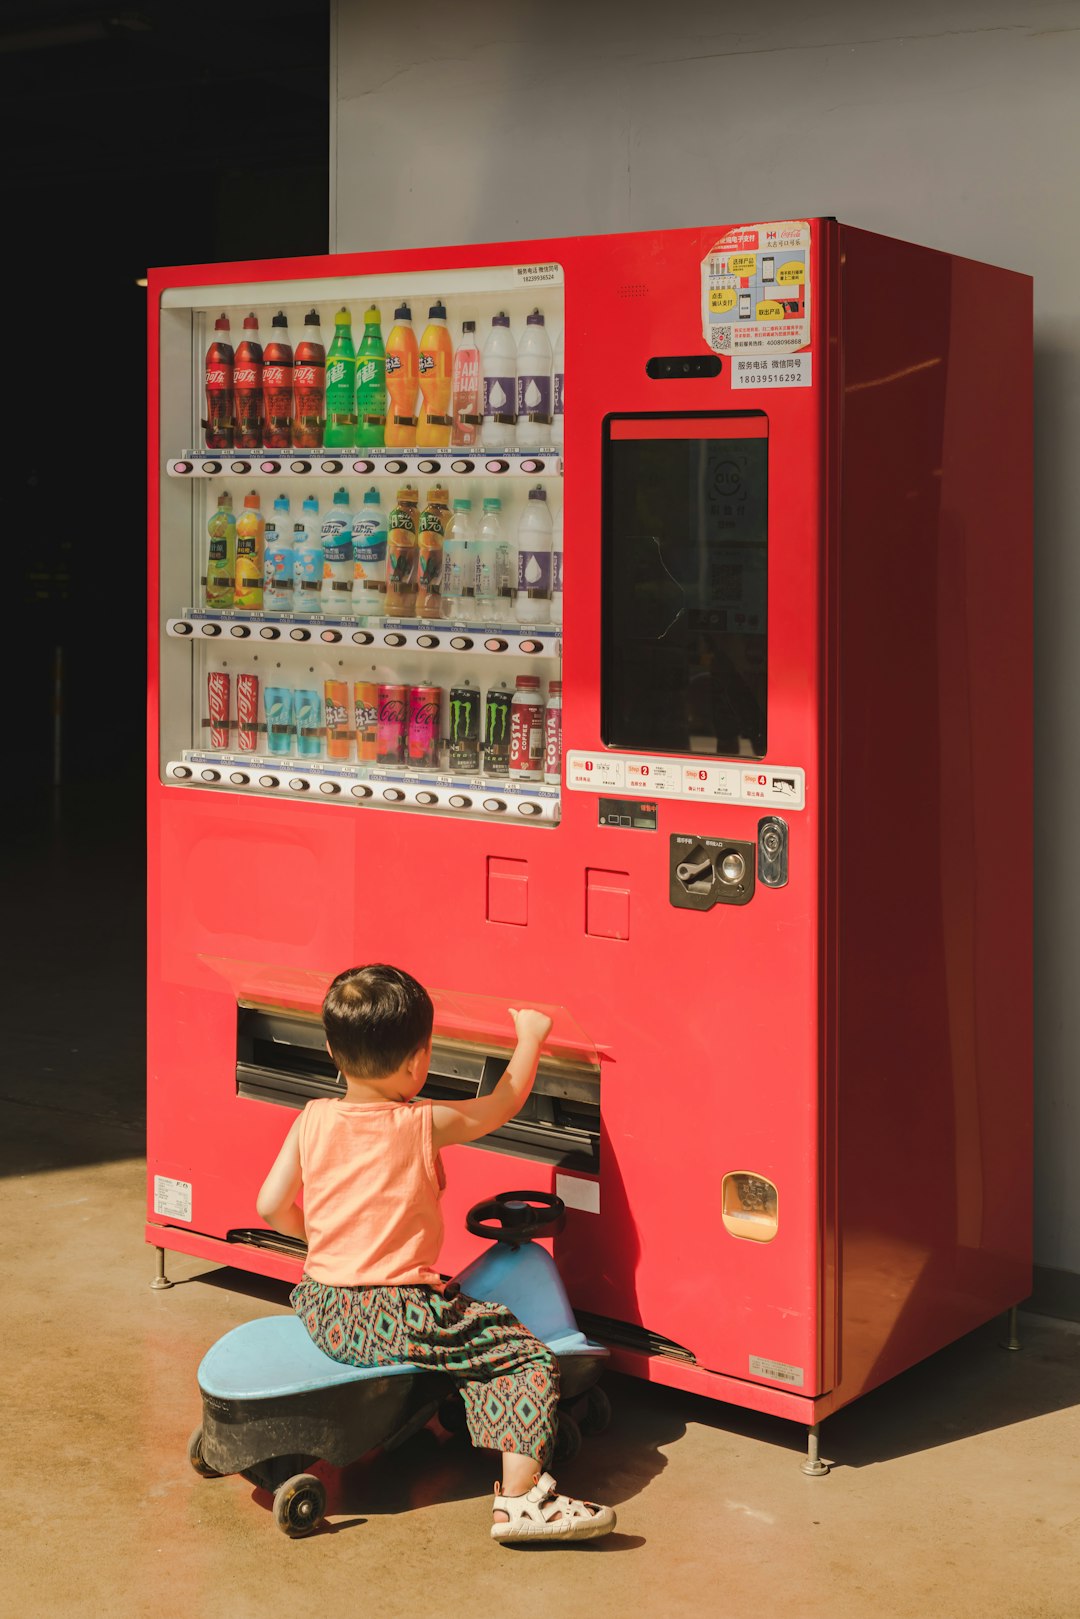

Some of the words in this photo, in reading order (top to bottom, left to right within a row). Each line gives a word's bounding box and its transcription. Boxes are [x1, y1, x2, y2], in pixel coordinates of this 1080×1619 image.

[738, 360, 768, 370] 服务电话
[772, 359, 802, 368] 微信同号
[740, 374, 802, 384] 18039516292
[511, 713, 521, 760] COSTA
[547, 718, 556, 765] COSTA
